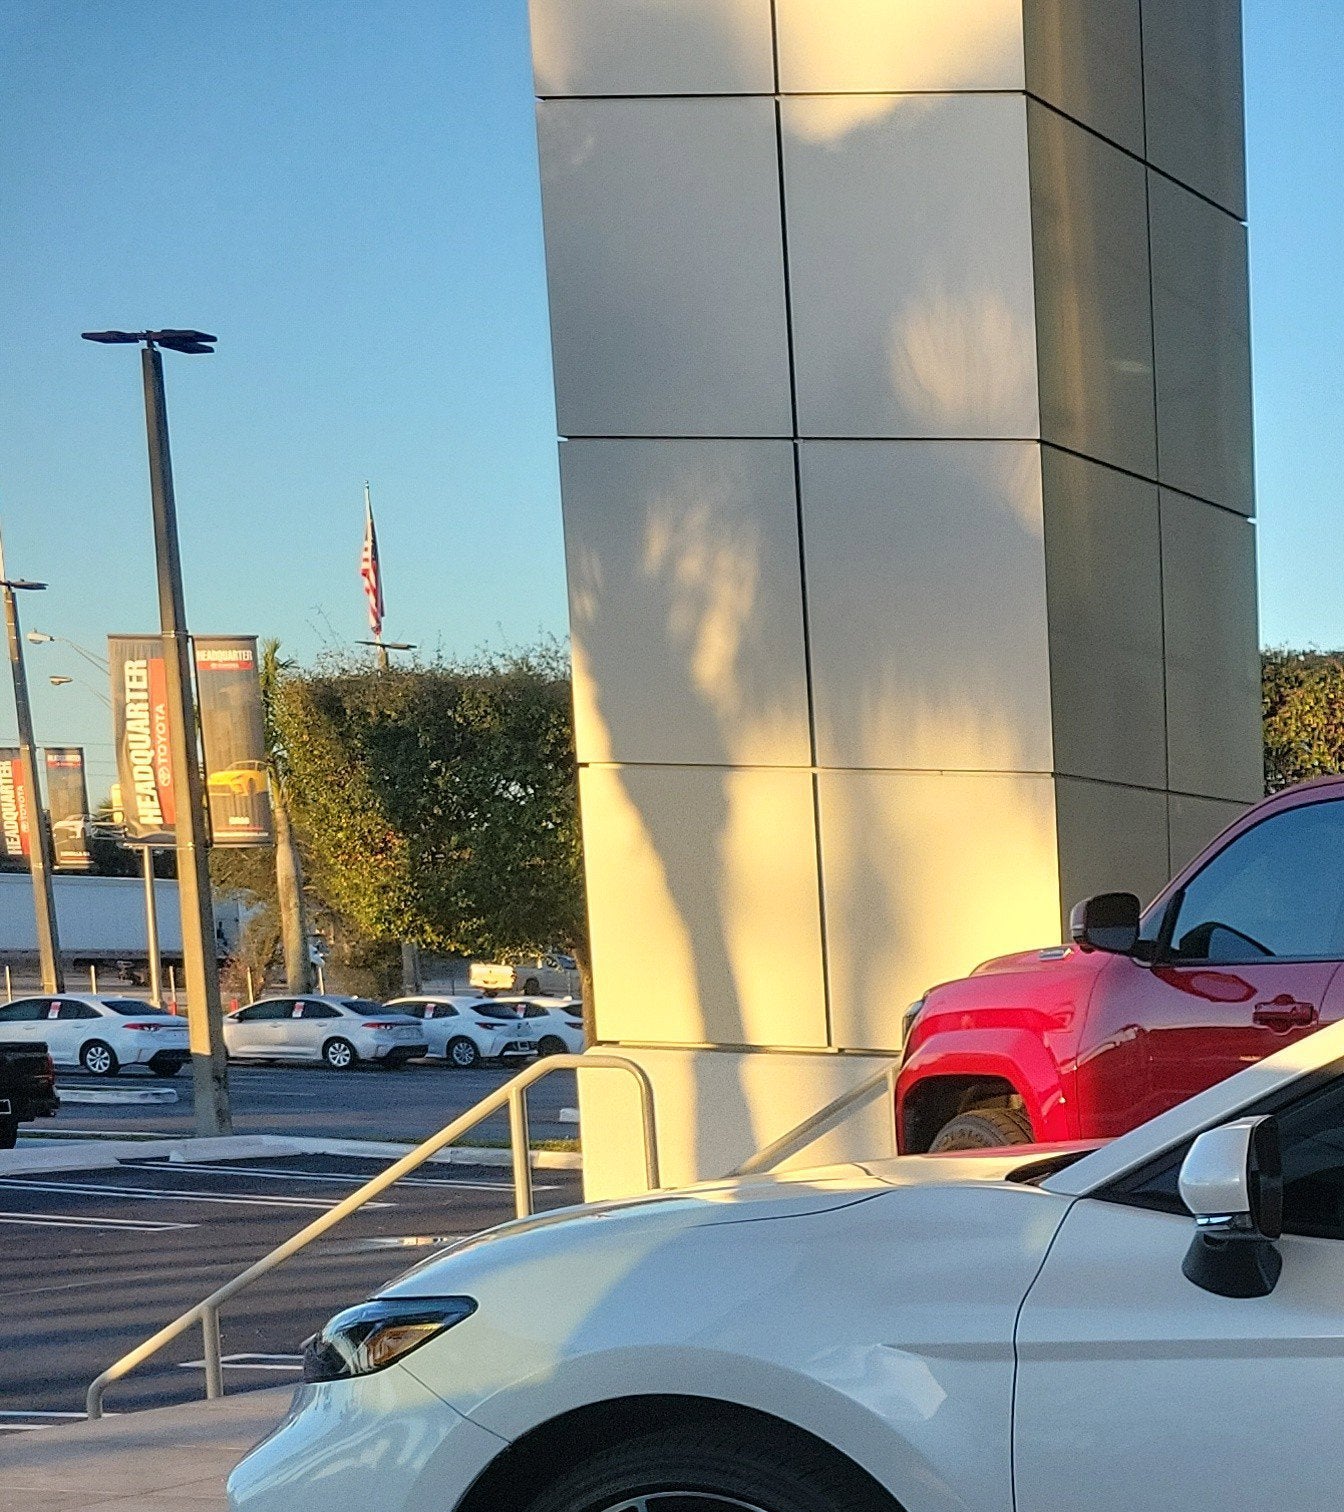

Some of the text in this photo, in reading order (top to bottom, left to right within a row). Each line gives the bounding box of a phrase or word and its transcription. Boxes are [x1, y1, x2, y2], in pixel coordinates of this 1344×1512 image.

[124, 659, 164, 825] HEADQUARTER
[154, 703, 169, 766] TOYOTA
[0, 760, 23, 855] HEADQUARTER
